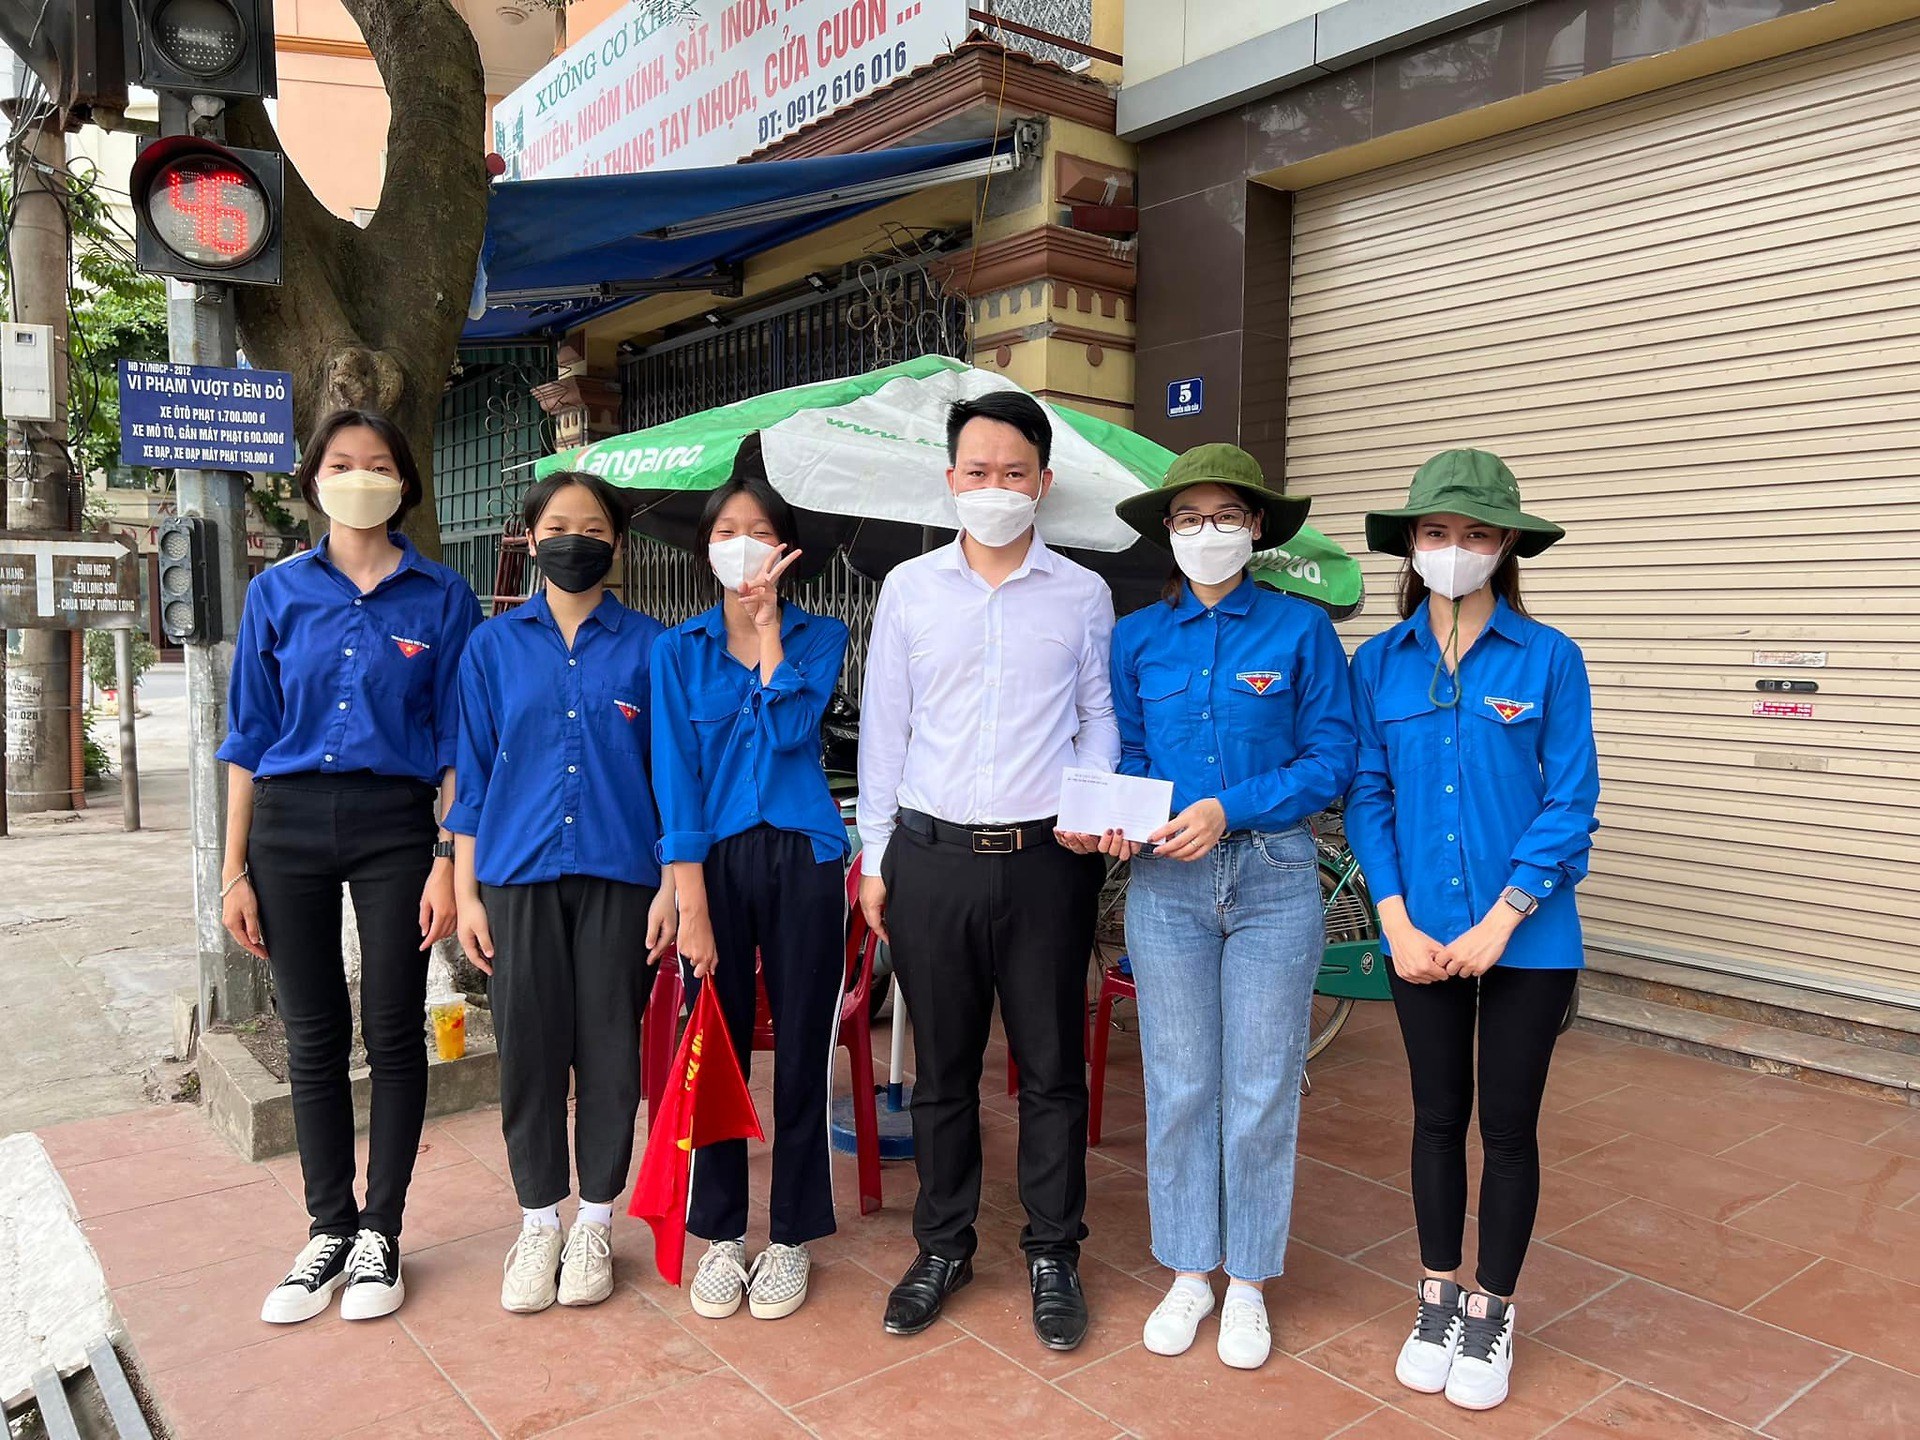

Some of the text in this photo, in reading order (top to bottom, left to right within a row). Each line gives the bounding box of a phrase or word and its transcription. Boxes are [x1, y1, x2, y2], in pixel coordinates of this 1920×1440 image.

[535, 51, 598, 117] XƯỞNG
[602, 23, 628, 67] CƠ
[521, 120, 574, 179] CHUYÊN:
[577, 86, 621, 146] NHÔM
[626, 55, 669, 115] KÍNH,
[721, 0, 777, 53] INOX,
[604, 128, 655, 175] THANG
[659, 105, 691, 158] TAY
[697, 69, 757, 137] NHỰA,
[764, 24, 809, 98] CỬA
[758, 41, 907, 144] ĐT: 0912 616 016
[165, 170, 248, 254] 46
[174, 365, 191, 376] 2012
[127, 373, 285, 401] VI PHẠM VƯỢT ĐÈN ĐỎ
[1179, 383, 1192, 403] 5
[160, 405, 172, 419] XE
[192, 408, 215, 424] PHẠT
[217, 410, 258, 424] 1.700.000
[132, 423, 144, 437] XE
[146, 422, 161, 438] MÔ
[199, 426, 218, 441] MÁY
[220, 429, 242, 445] PHẠT
[143, 444, 153, 458] XE
[174, 446, 184, 459] XE
[201, 447, 218, 461] MÁY
[219, 450, 239, 465] PHẠT
[573, 444, 705, 481] Kangaroo
